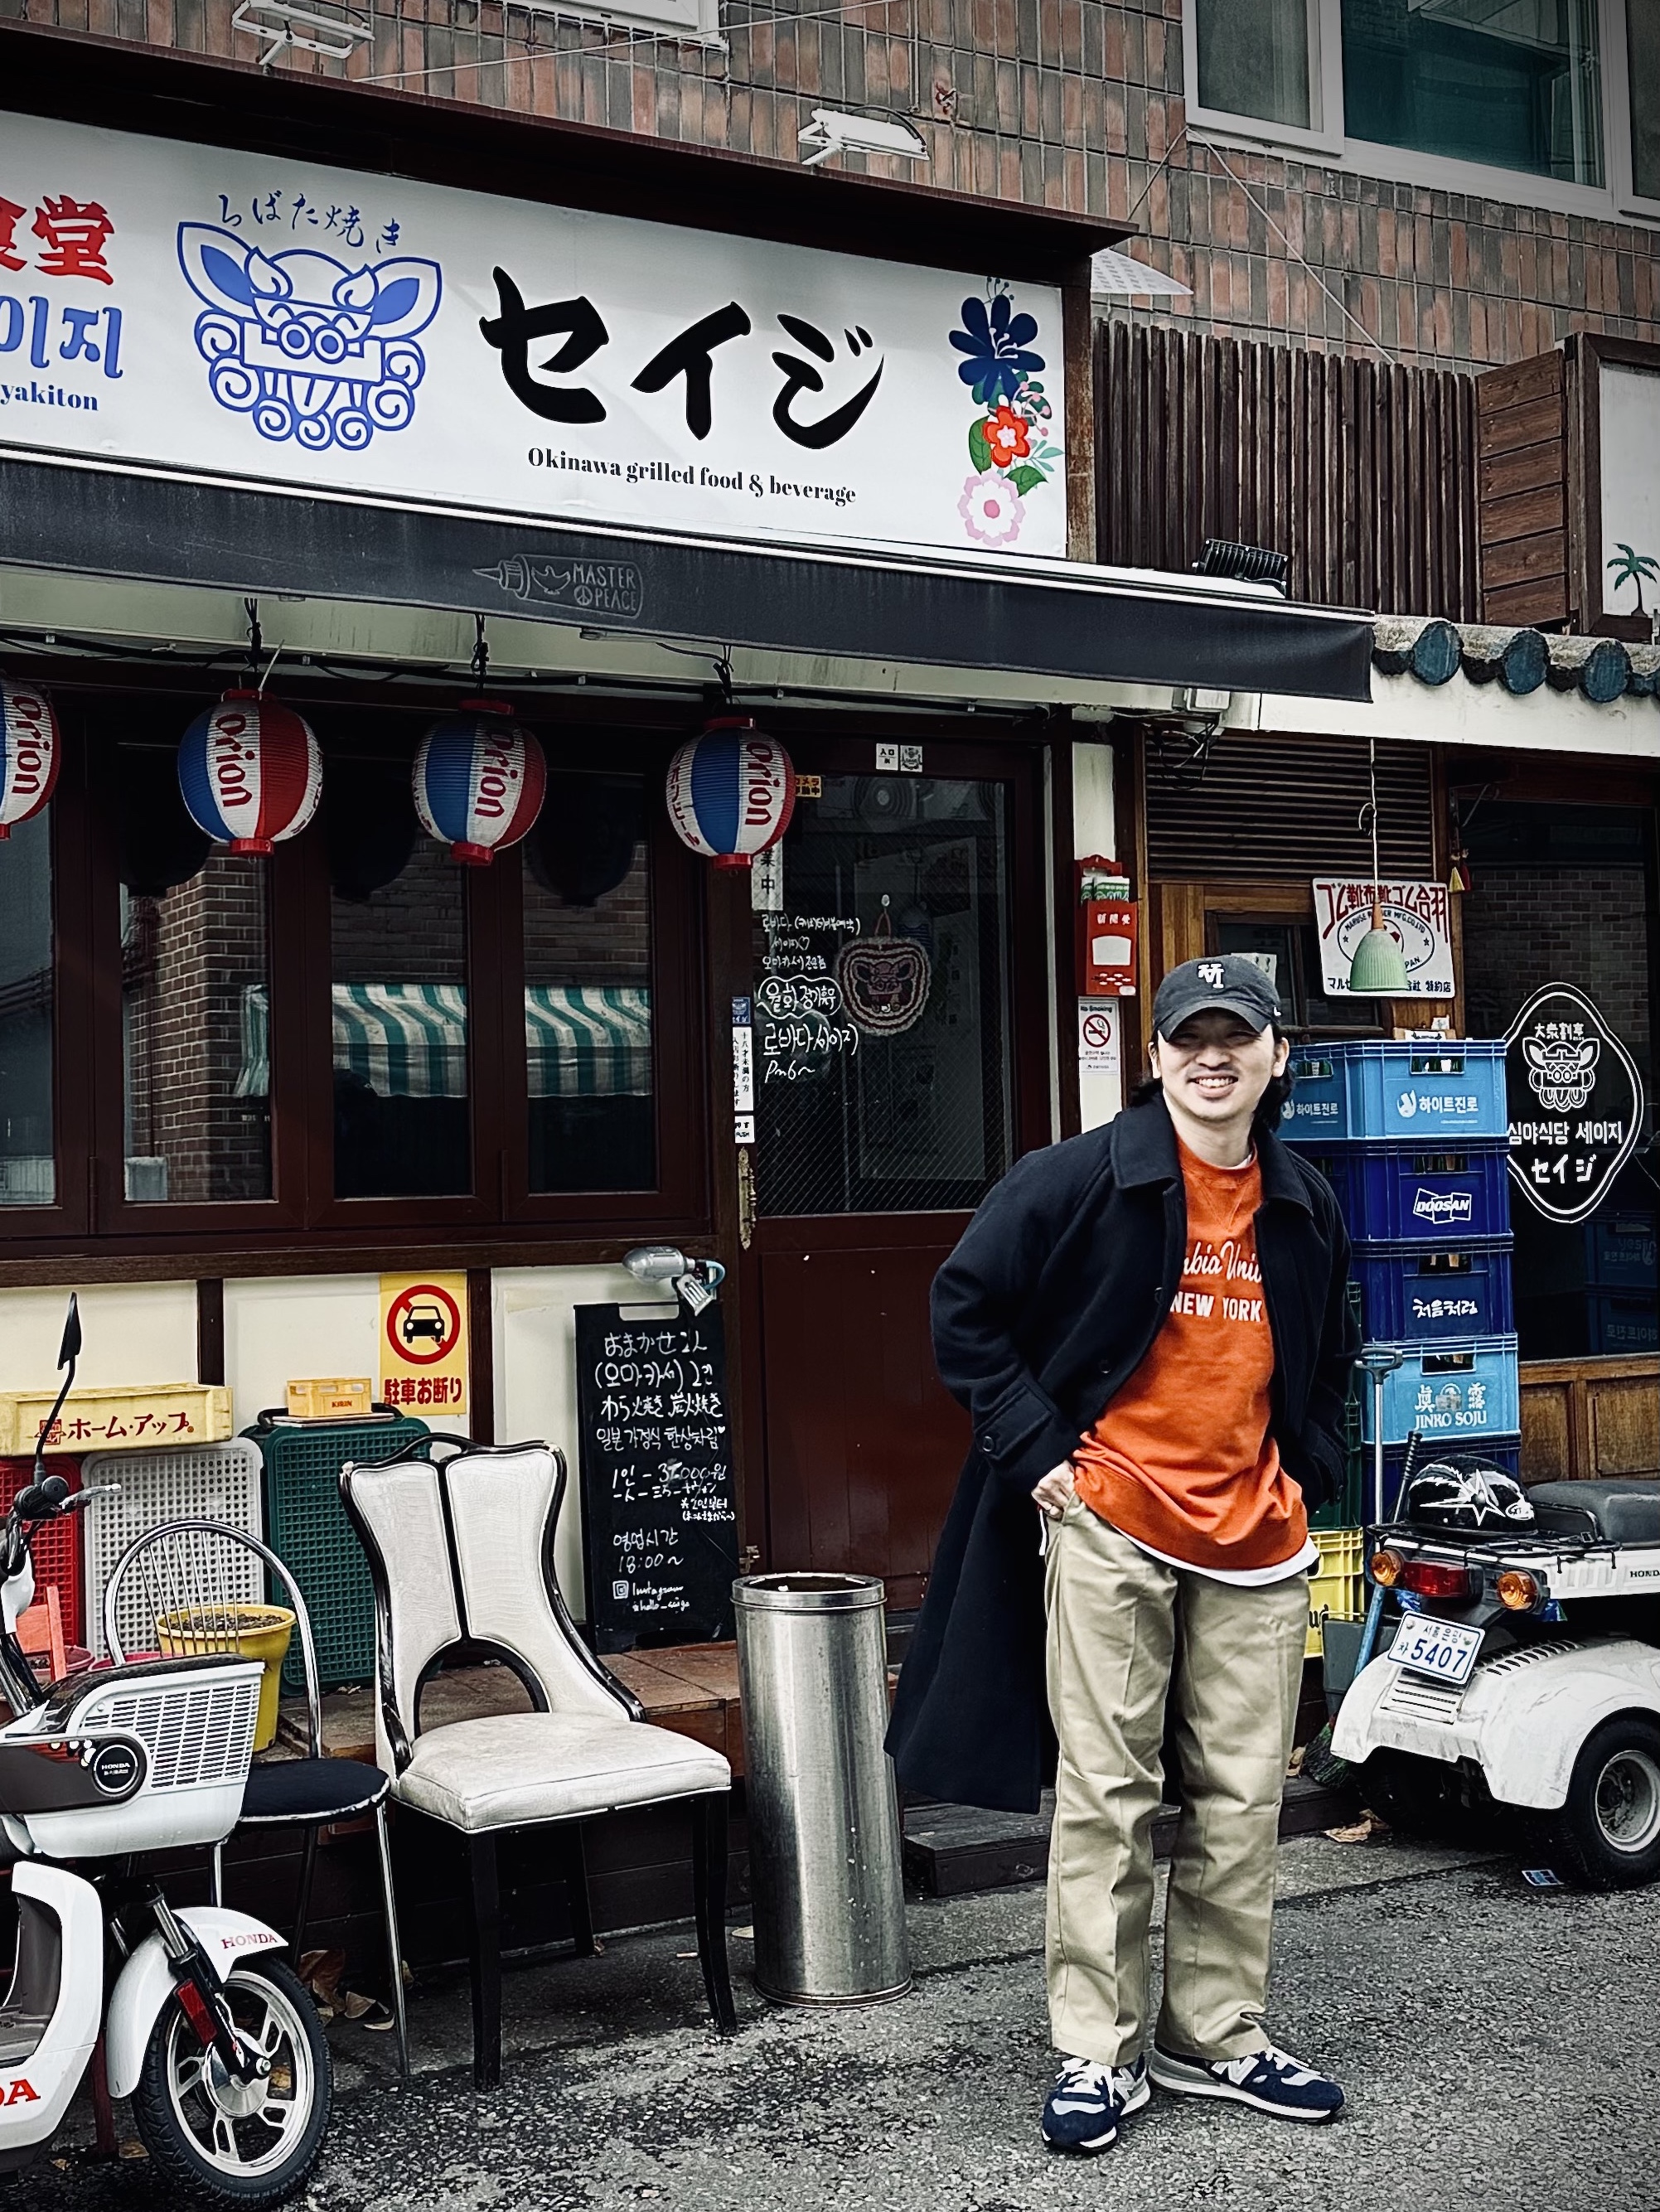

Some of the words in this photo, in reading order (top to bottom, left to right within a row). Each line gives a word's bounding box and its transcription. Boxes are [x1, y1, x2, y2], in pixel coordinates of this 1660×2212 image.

[478, 265, 883, 450] セイジ
[0, 380, 99, 411] yakiton
[528, 448, 622, 476] Okinawa
[626, 462, 694, 483] grilled
[700, 467, 743, 491] food
[748, 473, 764, 497] &
[769, 475, 856, 507] beverage
[573, 562, 636, 589] MASTER
[595, 588, 636, 612] PEACE
[1296, 1103, 1338, 1116] 하이트진로
[1419, 1096, 1479, 1114] 하이트진로
[1508, 1122, 1569, 1145] 심야식당
[1575, 1121, 1623, 1145] 세이지
[1532, 1154, 1597, 1183] セイジ
[1416, 1200, 1469, 1212] DOOSAN
[1170, 1291, 1215, 1318] NEW
[1222, 1296, 1262, 1322] YORK
[1412, 1298, 1479, 1318] 처음처럼
[385, 1377, 462, 1406] 駐車お断り
[1454, 1410, 1487, 1427] SOJU
[1630, 1570, 1660, 1578] HOND
[1411, 1638, 1468, 1672] 5407
[221, 1934, 278, 1949] HONDA
